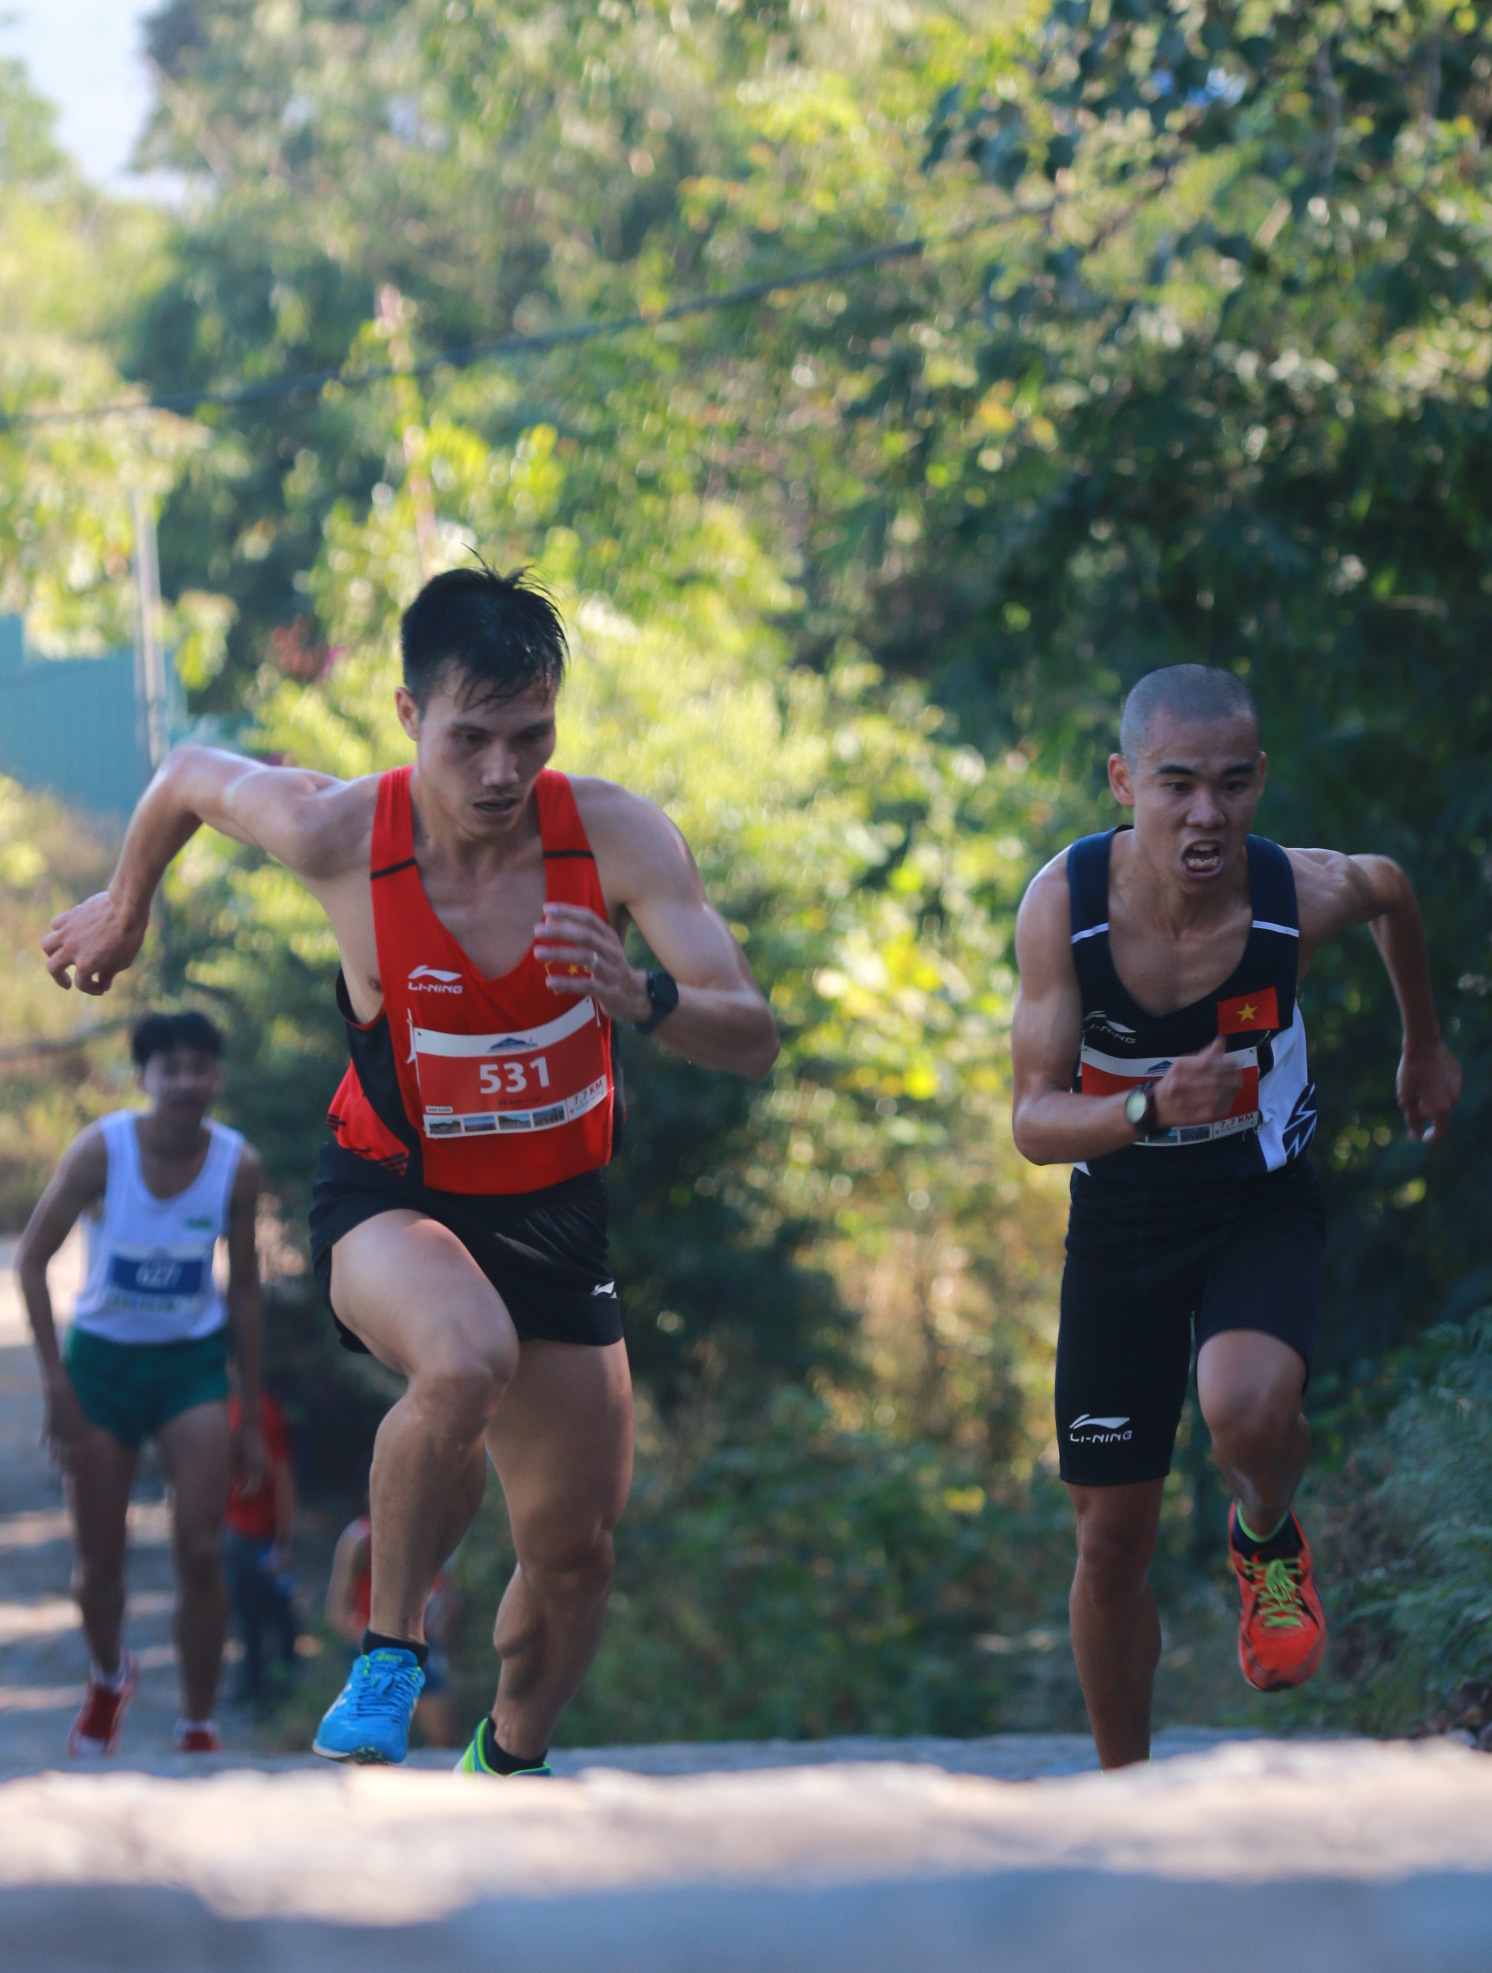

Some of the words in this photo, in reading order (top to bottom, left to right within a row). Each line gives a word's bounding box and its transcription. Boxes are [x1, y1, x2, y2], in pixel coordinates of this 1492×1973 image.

[408, 981, 463, 994] LI-NING
[1086, 1023, 1137, 1044] I-NING
[479, 1056, 550, 1094] 531
[589, 1079, 603, 1095] KM
[1238, 1113, 1254, 1124] KM
[1070, 1430, 1133, 1443] LI-NING
